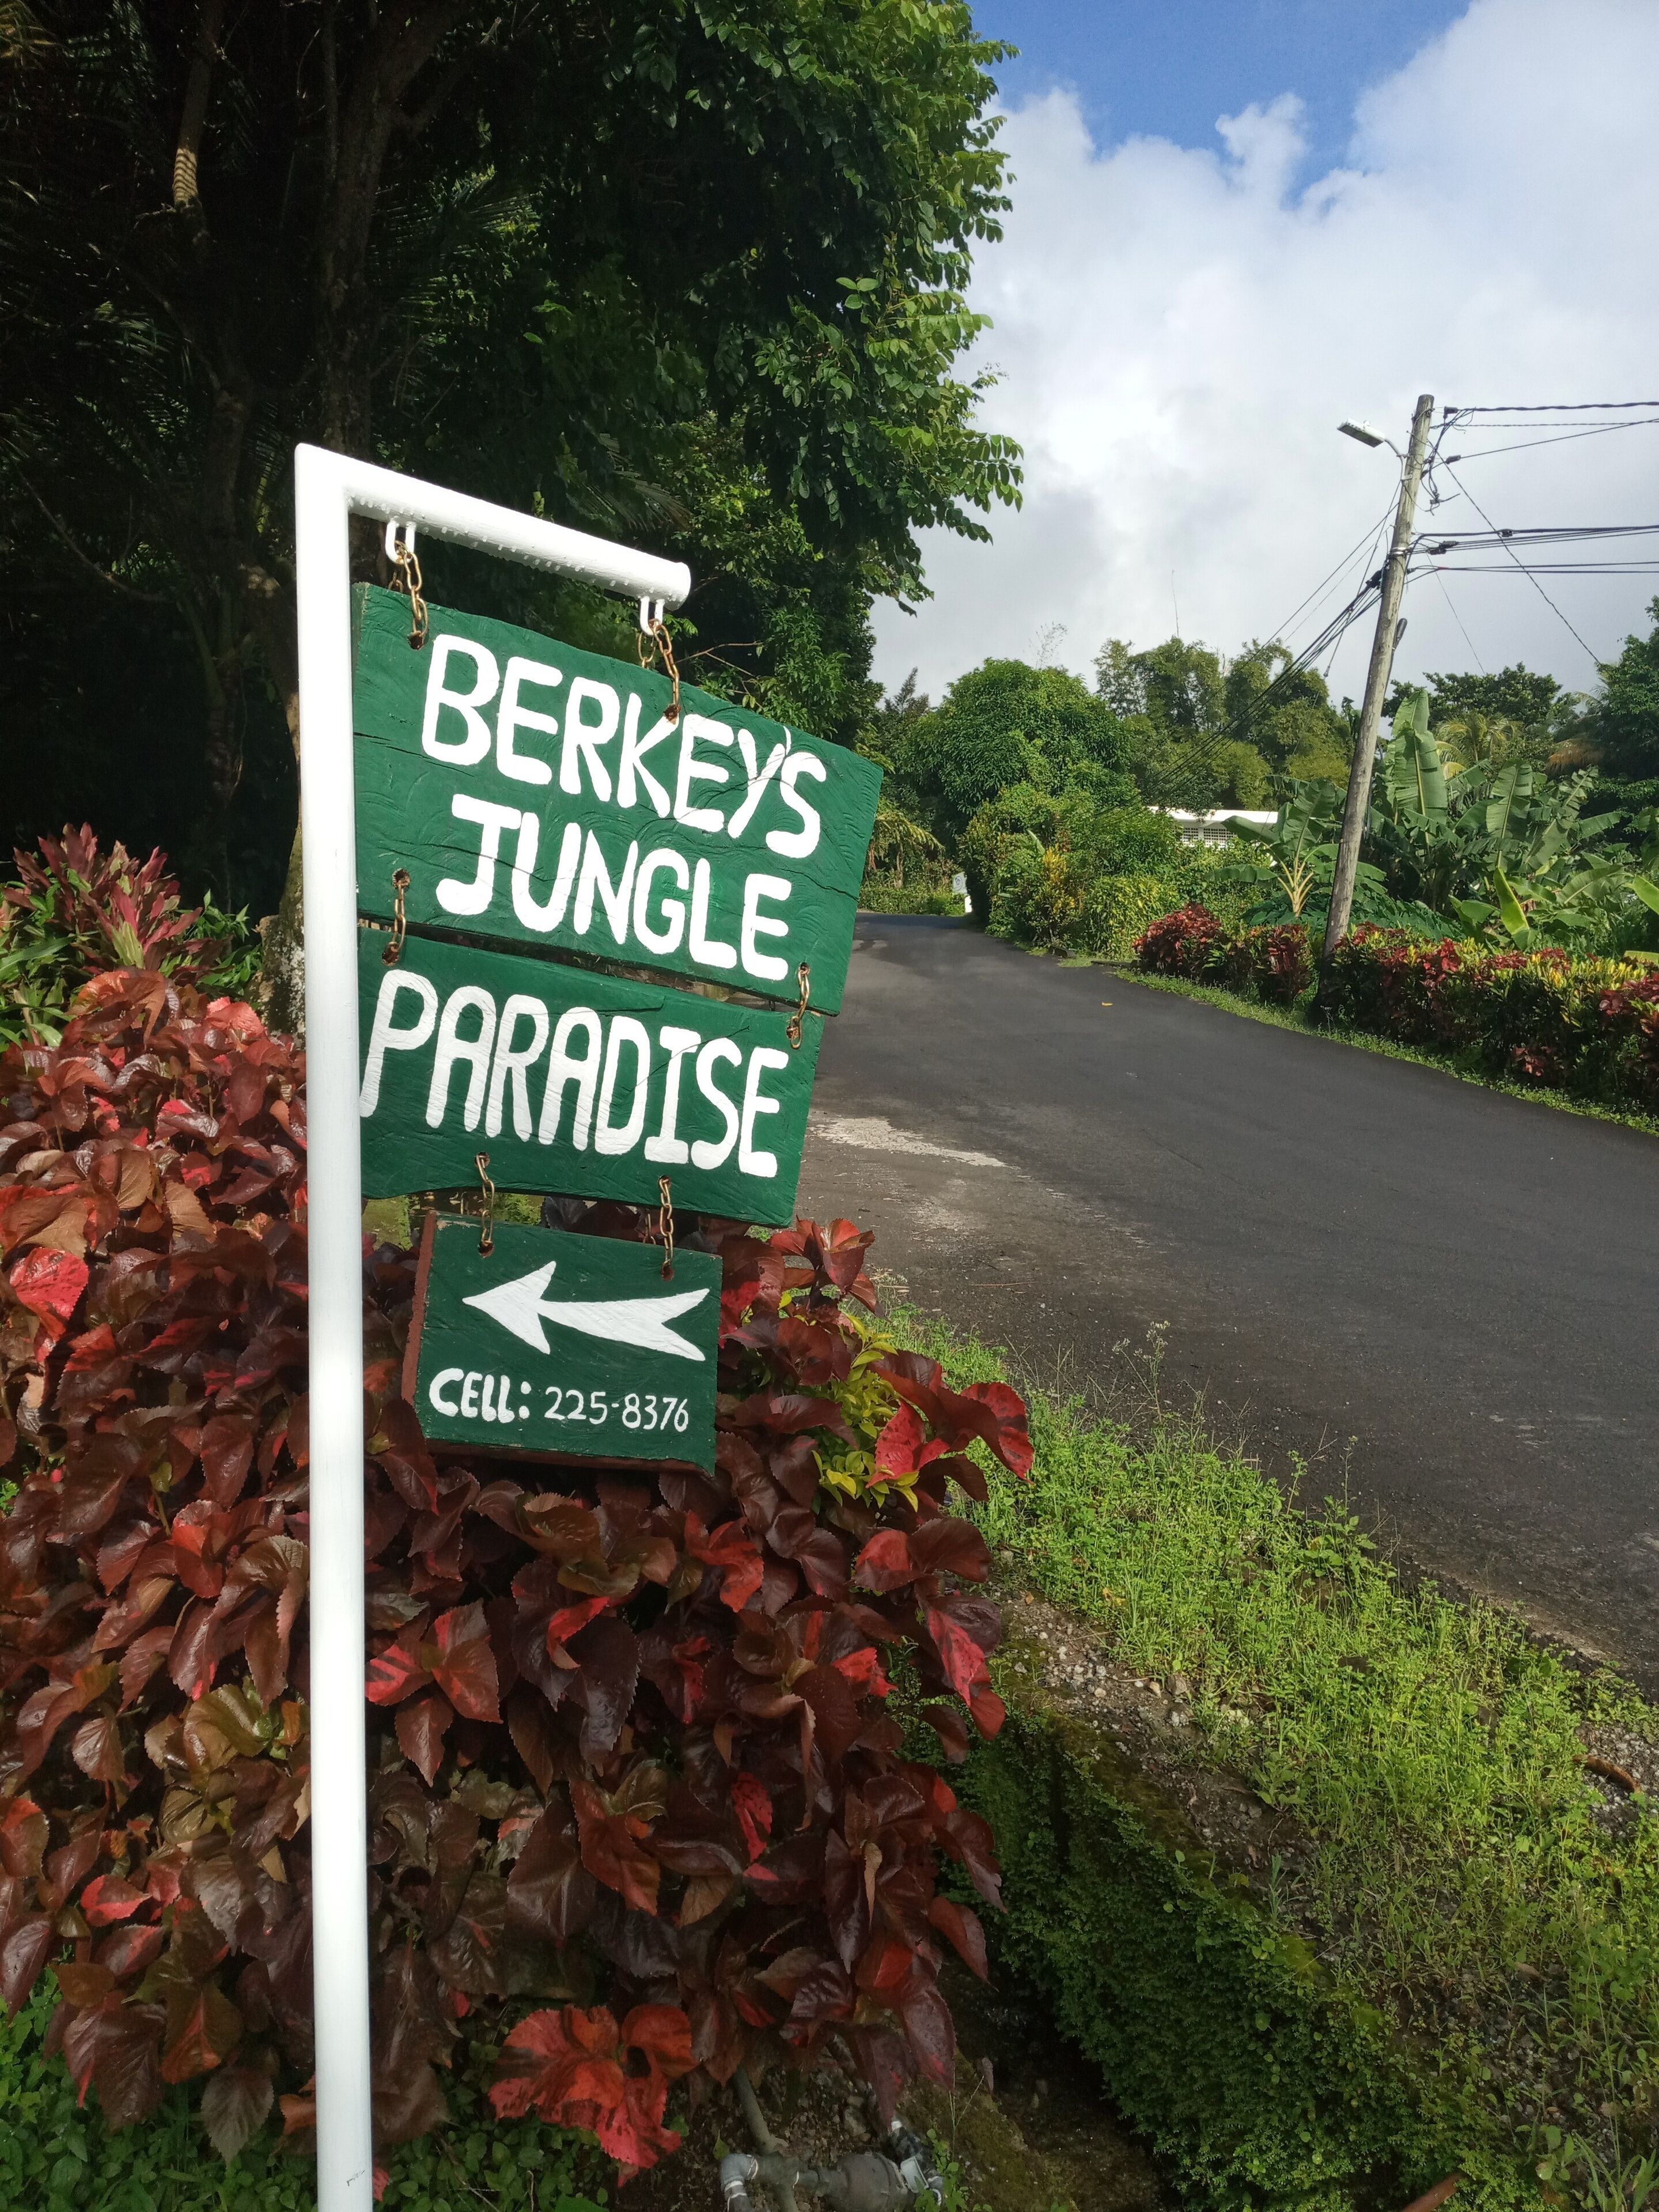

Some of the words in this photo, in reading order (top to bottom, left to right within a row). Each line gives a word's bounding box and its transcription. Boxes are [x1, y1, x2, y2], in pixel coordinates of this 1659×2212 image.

[421, 633, 827, 859] BERKEY'S
[435, 793, 793, 982] JUNGLE
[358, 969, 789, 1177] PARADISE
[429, 1368, 532, 1423] CELL:
[544, 1385, 689, 1433] 225-8376
